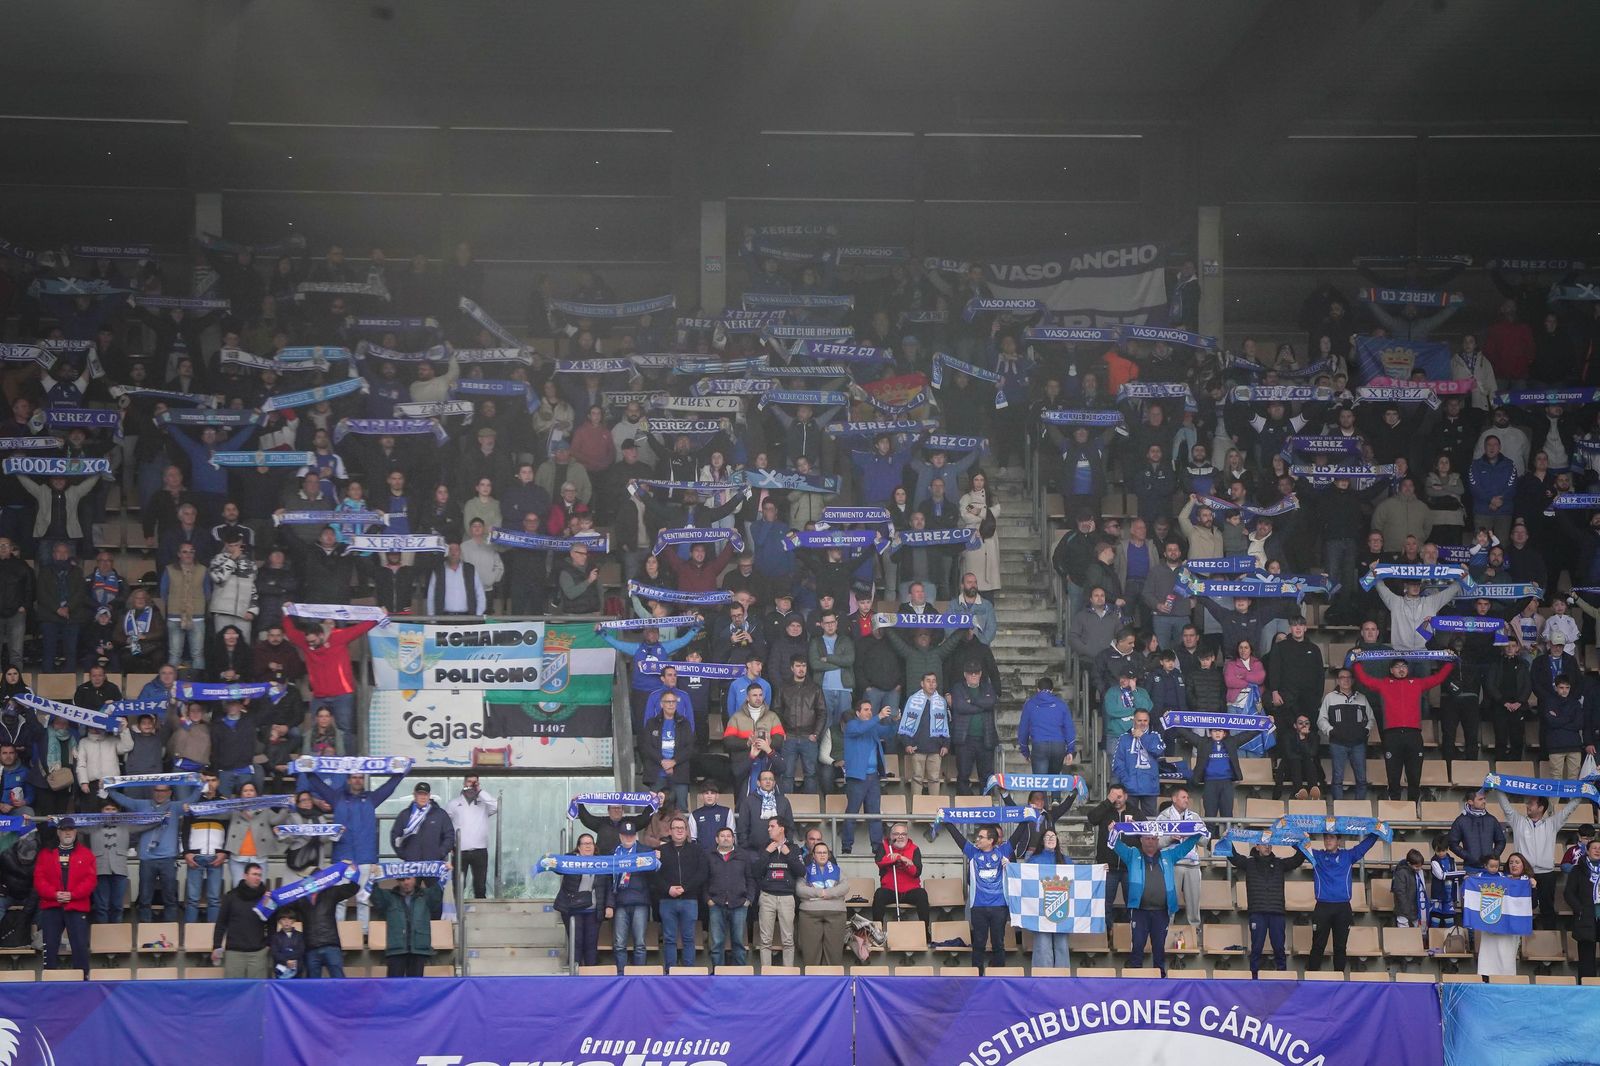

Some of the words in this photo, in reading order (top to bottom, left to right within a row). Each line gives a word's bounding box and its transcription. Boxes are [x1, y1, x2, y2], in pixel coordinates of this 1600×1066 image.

[761, 226, 803, 234] XEREZ
[839, 248, 861, 257] VASO
[863, 248, 893, 257] ANCHO
[990, 262, 1063, 282] VASO
[1069, 244, 1158, 272] ANCHO
[1501, 259, 1546, 269] XEREZ
[1547, 259, 1568, 269] CD
[1400, 291, 1437, 302] XEREZ
[979, 299, 1004, 308] VASO
[1005, 299, 1035, 308] ANCHO
[724, 319, 762, 330] XEREZ
[774, 327, 795, 336] XEREZ
[796, 327, 816, 336] CLUB
[1044, 328, 1068, 338] VASO
[1069, 329, 1102, 339] ANCHO
[1133, 328, 1157, 338] VASO
[1158, 330, 1189, 342] ANCHO
[813, 343, 856, 355] XEREZ
[857, 348, 876, 357] CD
[713, 381, 754, 391] XEREZ
[755, 381, 771, 391] CD
[1439, 381, 1459, 391] CD
[1295, 389, 1312, 398] CD
[1368, 389, 1422, 399] XEREZ
[50, 411, 93, 423] XEREZ
[650, 421, 693, 431] XEREZ
[848, 422, 896, 431] XEREZ
[958, 438, 978, 447] CD
[10, 459, 66, 473] HOOLS
[824, 511, 864, 520] SENTIMIENTO
[663, 532, 703, 540] SENTIMIENTO
[704, 531, 730, 539] AZULINO
[905, 529, 951, 542] XEREZ
[952, 528, 972, 540] CD
[367, 537, 427, 548] XEREZ
[1451, 550, 1471, 558] XER
[1391, 566, 1430, 576] XEREZ
[1434, 566, 1449, 576] CD
[638, 585, 665, 598] XEREZ
[1485, 586, 1515, 596] XEREZ!
[435, 630, 538, 647] KOMANDO
[702, 665, 729, 675] AZULINO
[435, 667, 538, 684] POLIGONO
[1183, 714, 1226, 725] SENTIMIENTO
[1228, 716, 1257, 727] AZULINO
[532, 723, 566, 733] 11407
[366, 758, 386, 770] CD
[1010, 776, 1050, 788] XEREZ
[1052, 777, 1068, 788] CD
[1505, 779, 1539, 789] XEREZ
[1539, 783, 1553, 791] CD
[577, 792, 621, 801] SENTIMIENTO
[622, 793, 652, 802] AZULINO
[949, 810, 981, 818] XEREZ
[982, 810, 996, 818] CD
[386, 863, 438, 876] KOLECTIVO
[562, 860, 594, 869] XEREZ
[594, 860, 609, 869] CD
[1046, 893, 1068, 916] XEREZ
[959, 999, 1191, 1066] ISTRIBUCIONES
[580, 1036, 634, 1056] Grupo
[642, 1036, 731, 1056] Logístico
